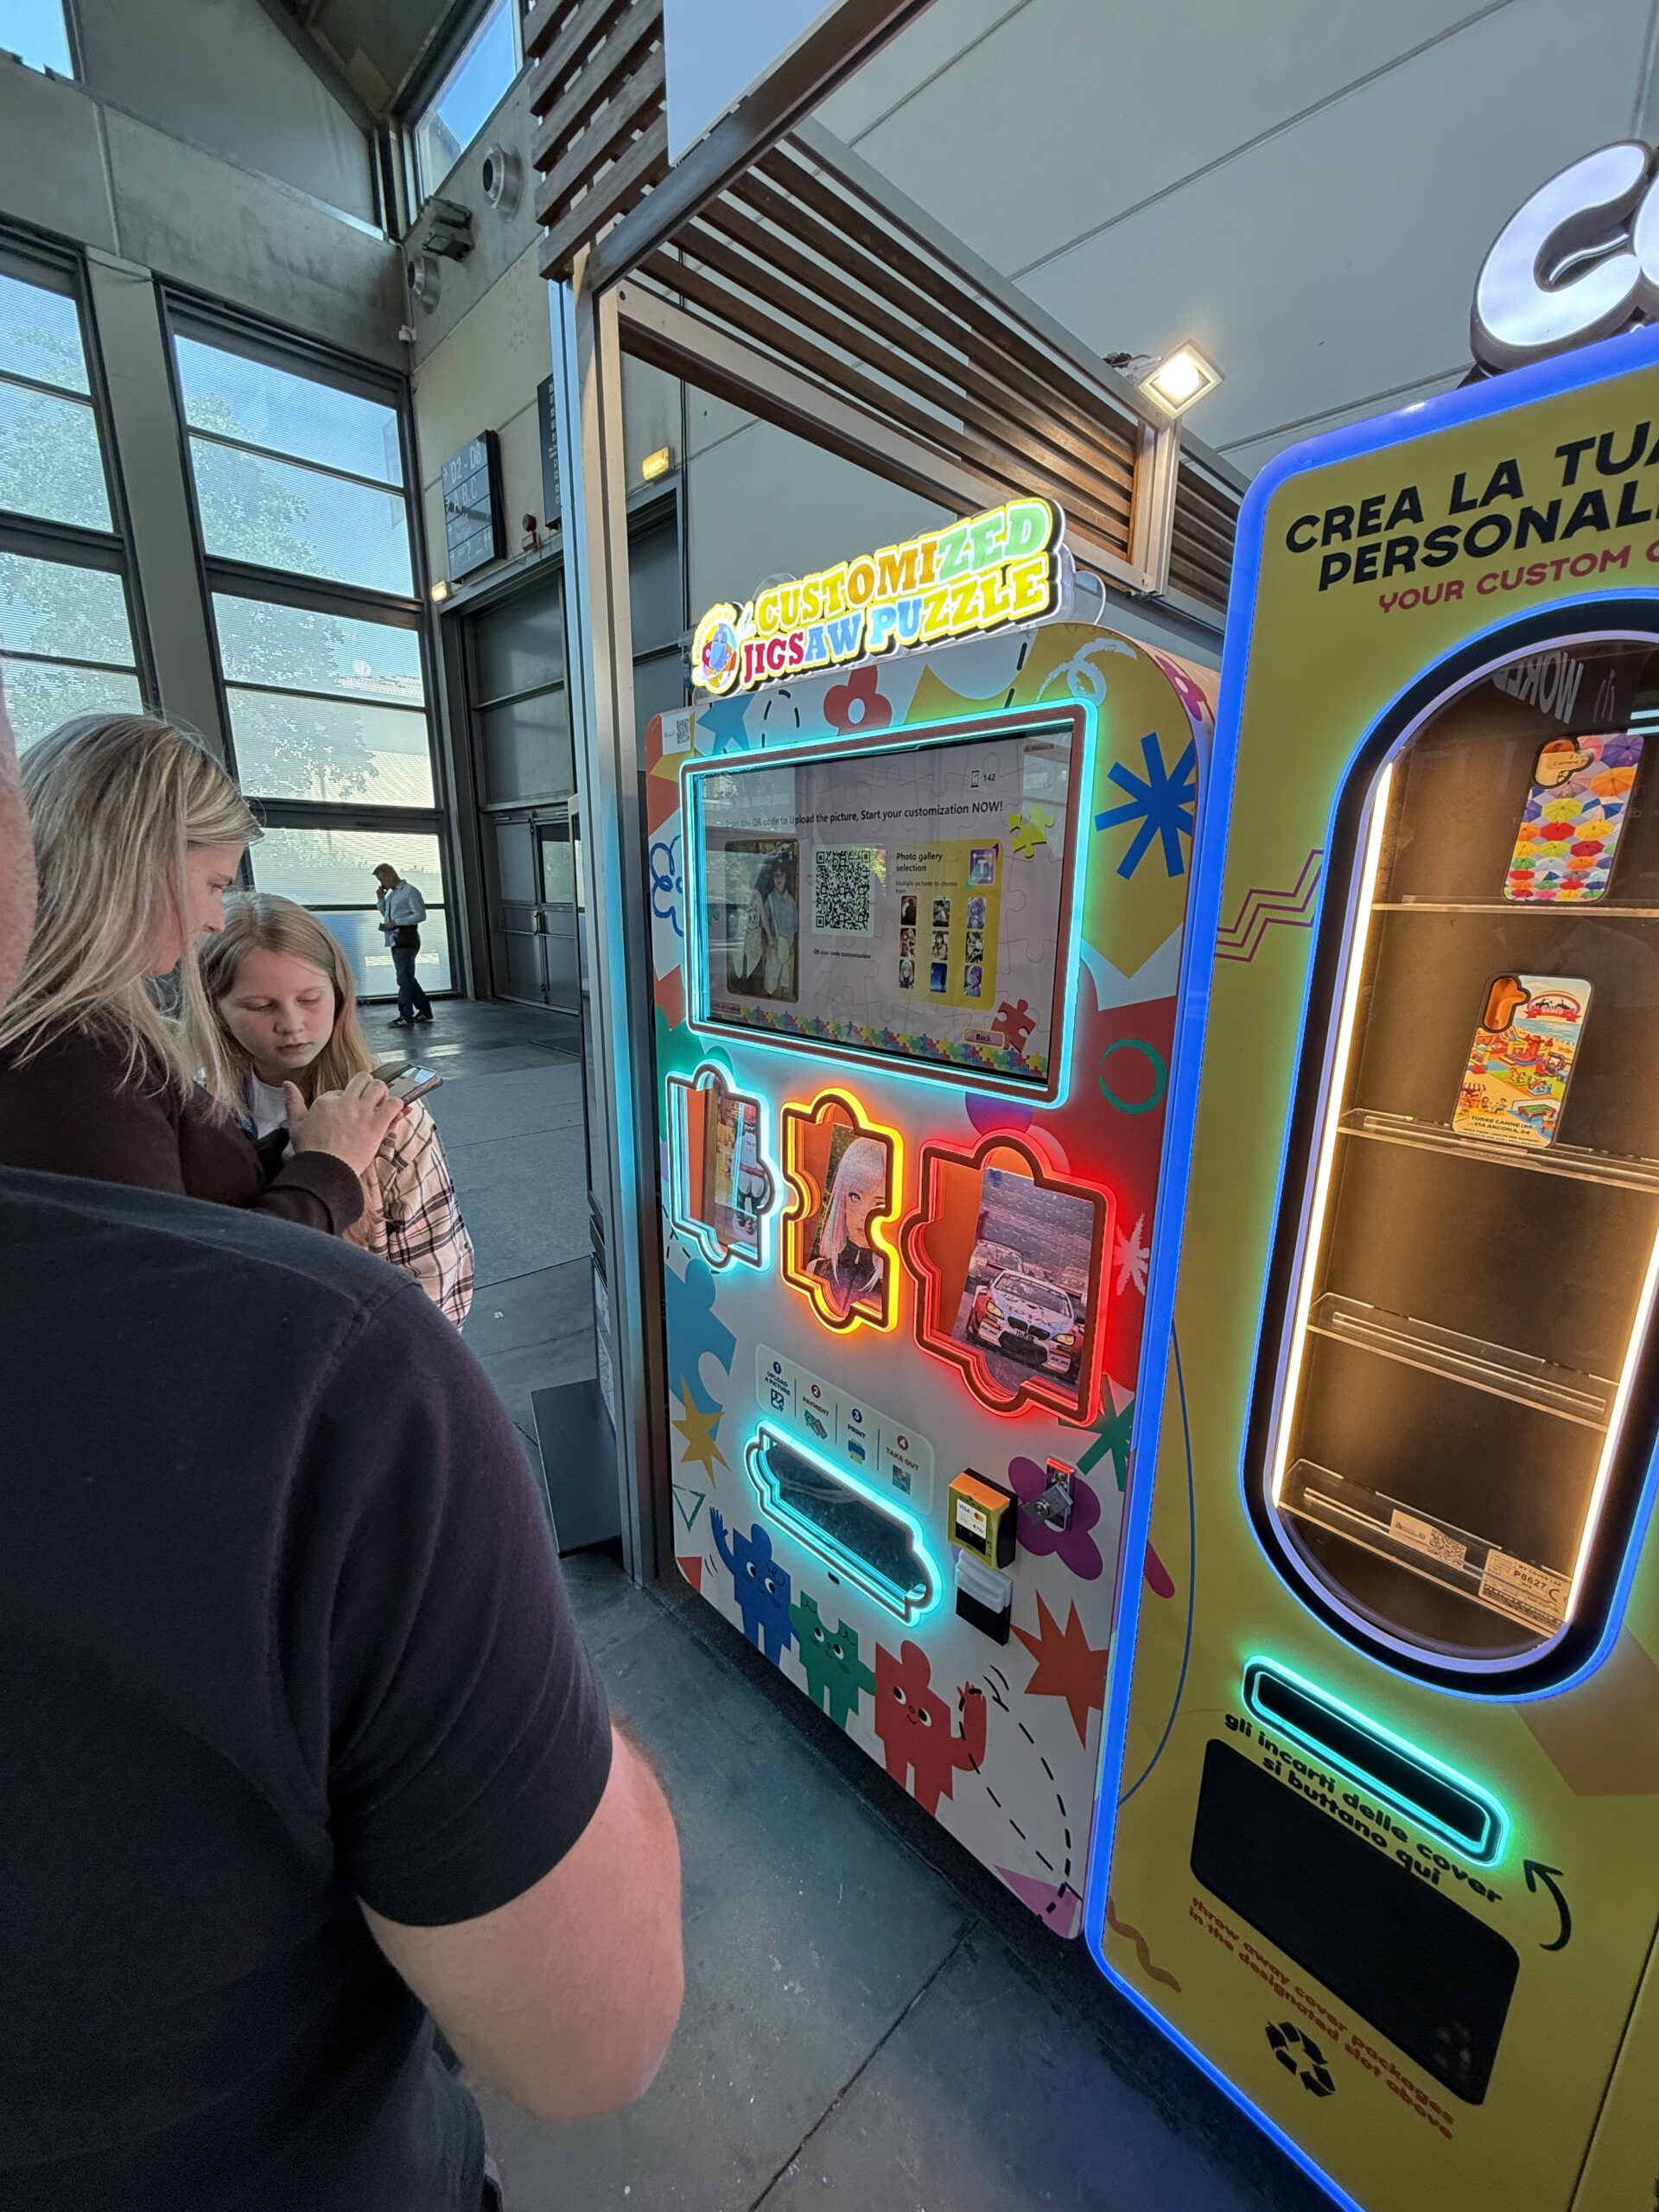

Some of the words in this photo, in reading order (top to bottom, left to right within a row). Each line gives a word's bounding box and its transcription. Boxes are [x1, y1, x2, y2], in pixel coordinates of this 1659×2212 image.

[1286, 486, 1424, 553] CREA
[1449, 459, 1524, 515] LA
[1318, 480, 1659, 592] PERSONAL
[757, 504, 1052, 632] CUSTOMIZED
[1378, 580, 1465, 613] YOUR
[1476, 544, 1631, 595] CUSTOM
[742, 616, 861, 683] JIGSAW
[869, 563, 1048, 645] PUZZLE
[982, 773, 995, 783] 142
[780, 816, 788, 824] to
[790, 814, 814, 825] Upload
[816, 812, 829, 823] the
[830, 810, 859, 825] picture,
[861, 810, 880, 821] Start
[882, 810, 902, 822] your
[904, 803, 969, 818] customization
[972, 800, 1004, 814] NOW!
[896, 852, 915, 861] Photo
[917, 851, 944, 864] gallery
[896, 862, 926, 873] selection
[976, 1033, 992, 1043] Back
[1496, 1118, 1521, 1127] CANNE
[766, 1371, 788, 1388] UPLOAD
[769, 1378, 791, 1396] PICTURE
[803, 1396, 830, 1417] PAYMENT
[848, 1424, 866, 1439] PRINT
[886, 1447, 905, 1463] TAKE
[904, 1459, 919, 1471] OUT
[958, 1502, 970, 1514] VISA
[1514, 1570, 1547, 1590] P8627
[1224, 1713, 1252, 1738] gli
[1258, 1732, 1335, 1793] incarti
[1343, 1786, 1408, 1843] delle
[1416, 1842, 1503, 1903] cover
[1262, 1756, 1281, 1776] si
[1287, 1770, 1388, 1849] buttano
[1395, 1847, 1443, 1885] qui
[1192, 1897, 1239, 1941] throw
[1243, 1942, 1290, 1985] away
[1294, 1986, 1347, 2032] cover
[1351, 2034, 1454, 2125] packages
[1189, 1906, 1204, 1926] in
[1207, 1923, 1234, 1952] the
[1238, 1951, 1339, 2043] designated
[1344, 2042, 1382, 2077] slot
[1386, 2078, 1453, 2141] above
